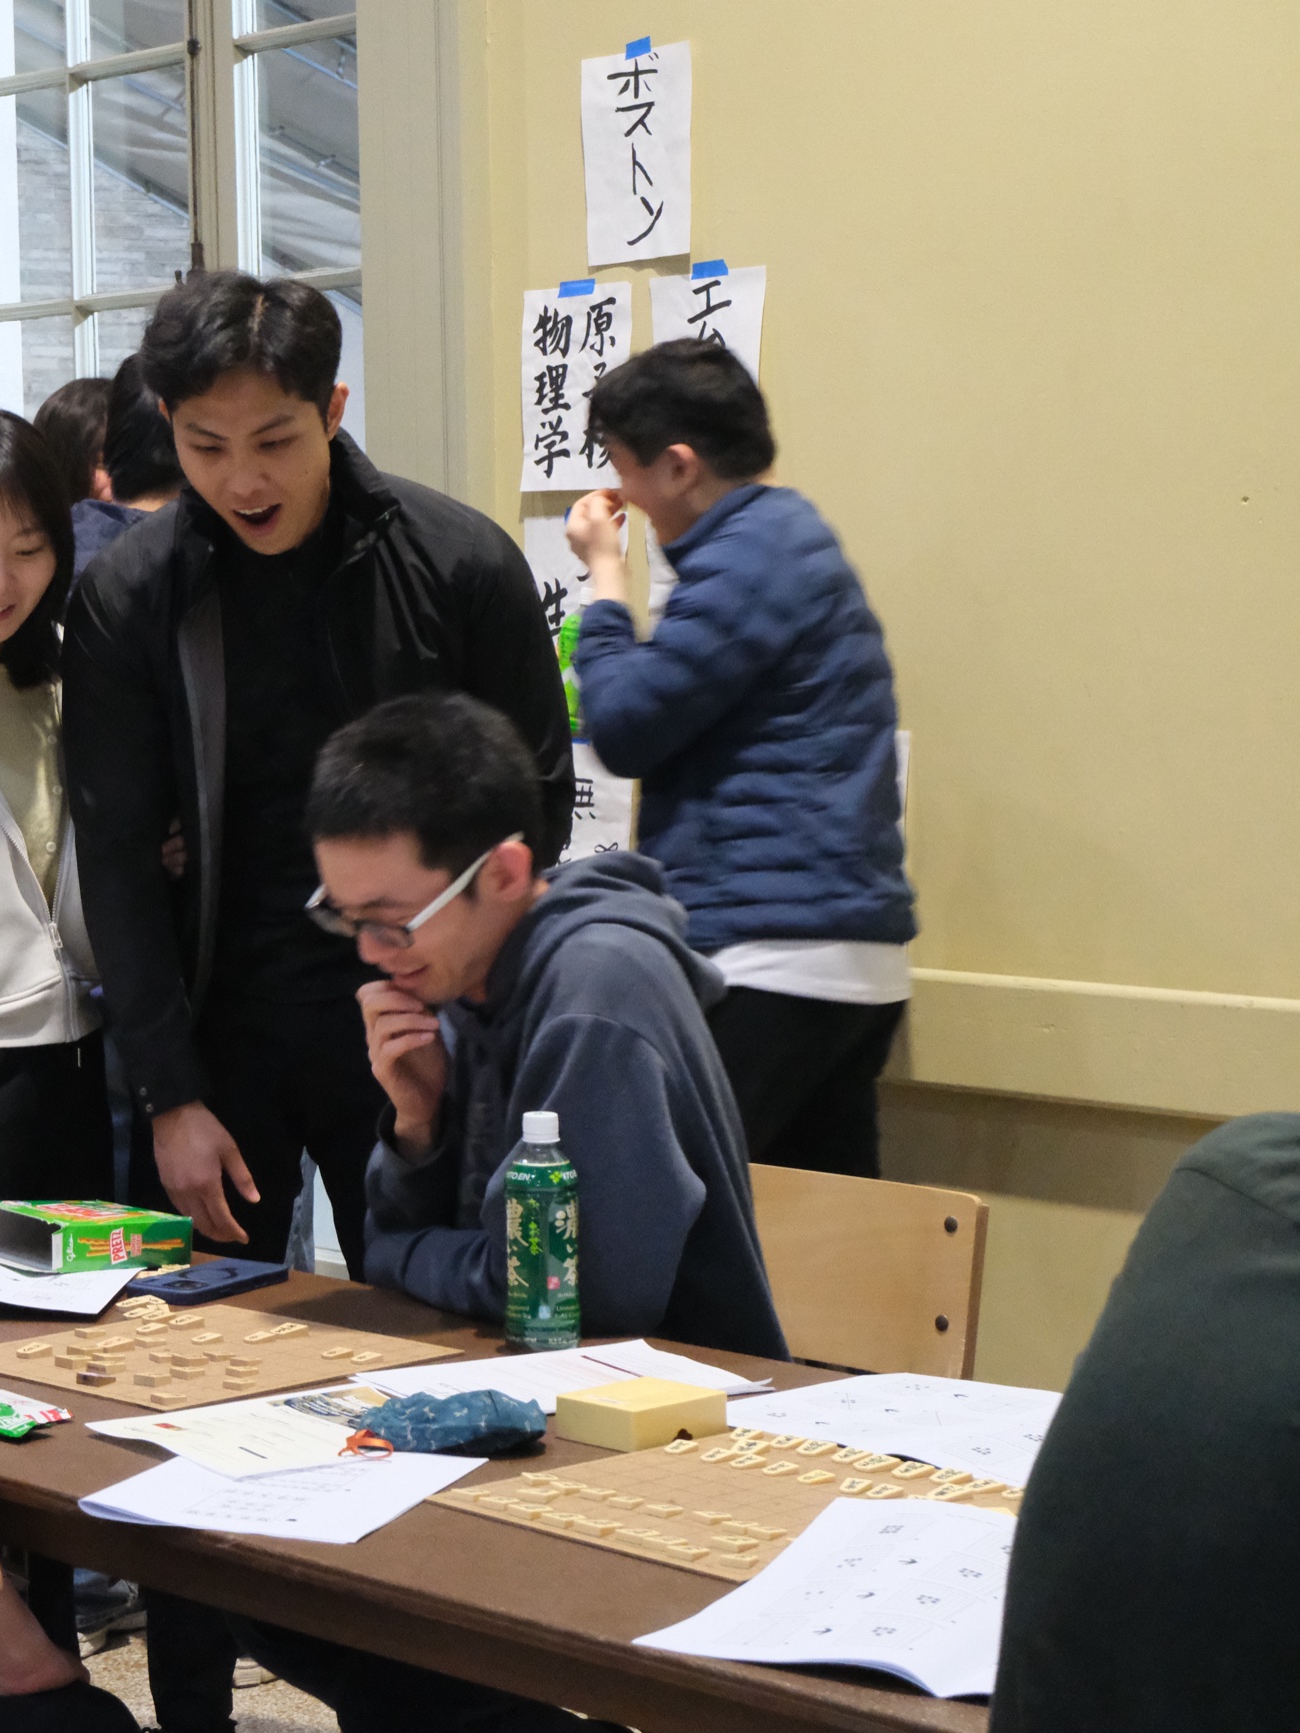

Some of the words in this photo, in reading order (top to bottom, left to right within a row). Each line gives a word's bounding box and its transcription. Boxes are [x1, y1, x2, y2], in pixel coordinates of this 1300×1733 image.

[606, 52, 664, 247] ボストン
[533, 304, 573, 479] 物理学
[111, 1230, 125, 1262] PRETZ
